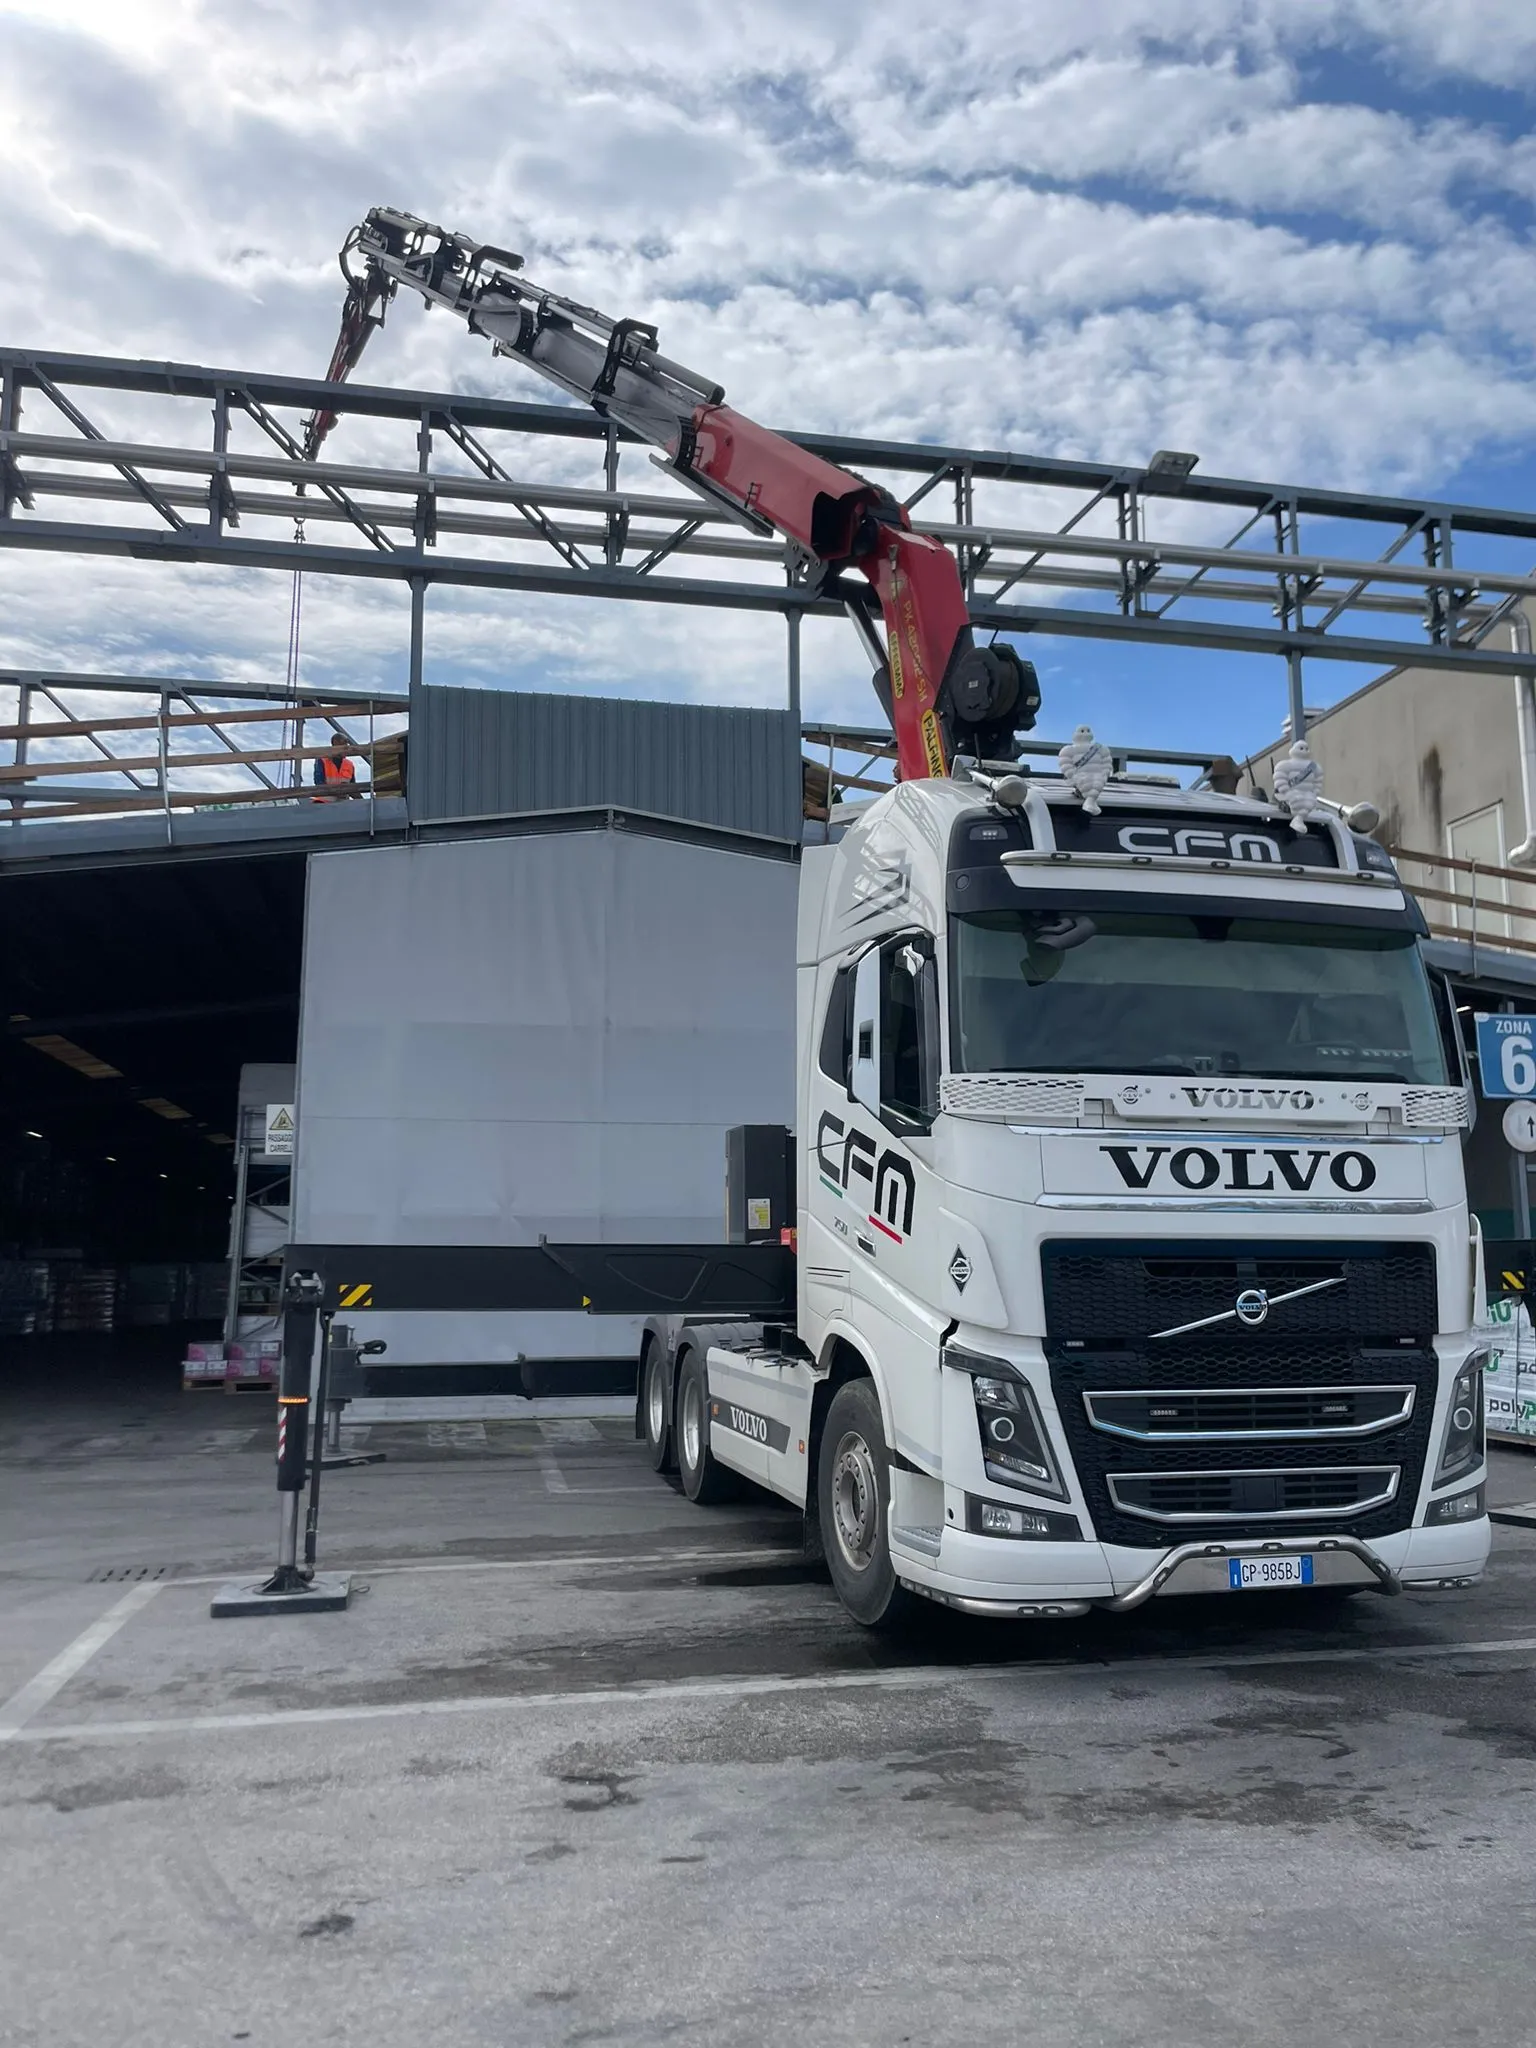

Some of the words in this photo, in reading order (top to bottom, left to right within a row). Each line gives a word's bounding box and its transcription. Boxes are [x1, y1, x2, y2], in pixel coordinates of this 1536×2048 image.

[1495, 1020, 1532, 1034] ZONA
[1501, 1035, 1536, 1096] 6
[1180, 1087, 1315, 1110] VOLVO
[1099, 1146, 1377, 1192] VOLVO
[730, 1405, 767, 1442] VOLVO
